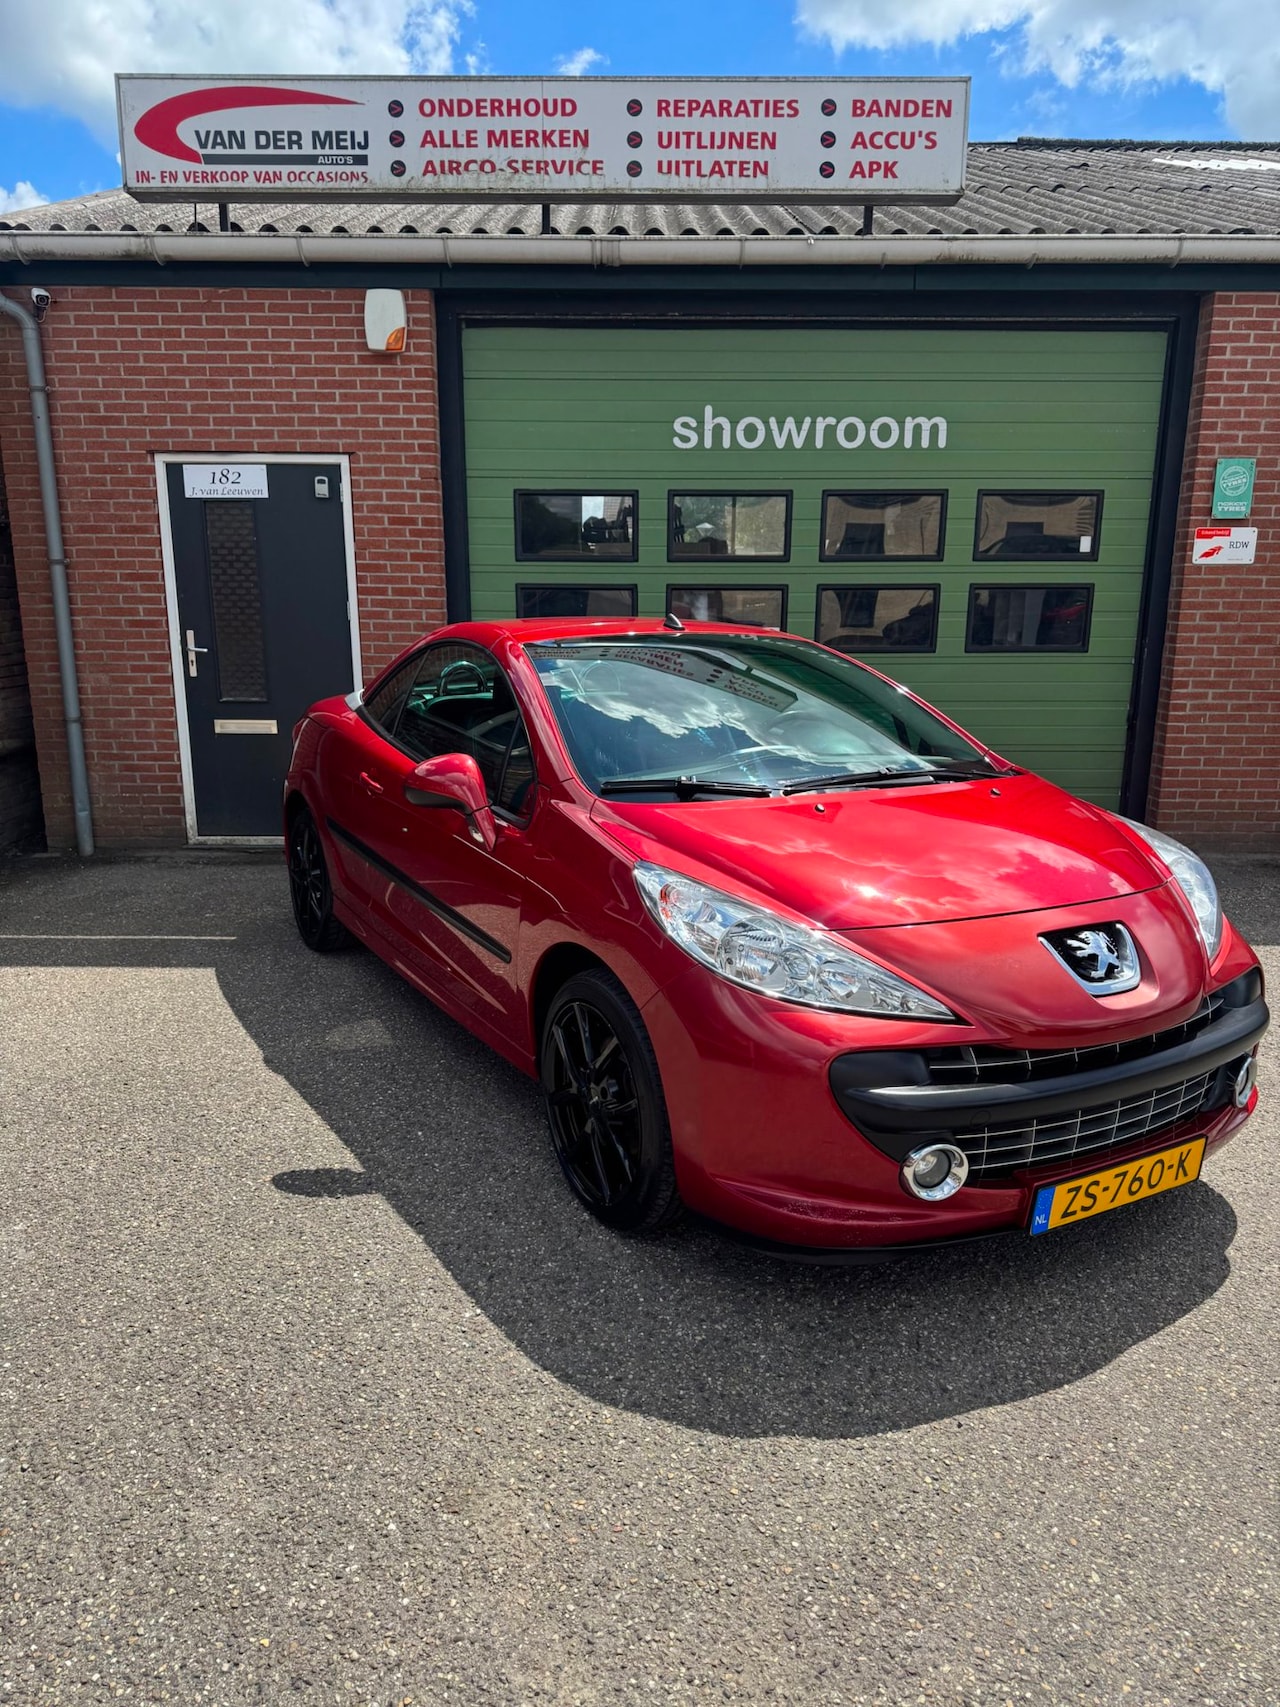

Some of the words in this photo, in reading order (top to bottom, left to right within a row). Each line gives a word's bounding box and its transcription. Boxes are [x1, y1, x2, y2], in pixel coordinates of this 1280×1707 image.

[418, 98, 577, 118] ONDERHOUD
[656, 99, 800, 118] REPARATIES
[851, 99, 952, 118] BANDEN
[195, 130, 246, 150] VAN
[254, 130, 303, 150] DER
[311, 130, 370, 150] MEIJ
[420, 129, 478, 148] ALLE
[487, 129, 590, 148] MERKEN
[657, 131, 777, 150] UITLIJNEN
[850, 131, 938, 150] ACCU'S
[317, 155, 354, 165] AUTO'S
[422, 160, 604, 176] AIRCO-SERVICE
[657, 160, 769, 178] UITLATEN
[135, 170, 156, 183] IN-
[160, 170, 179, 183] EN
[182, 170, 249, 184] VERKOOP
[253, 171, 283, 184] VAN
[287, 171, 369, 184] OCCASIONS
[849, 161, 899, 179] APK
[672, 404, 948, 449] showroom
[209, 468, 242, 485] 182
[189, 486, 198, 497] J.
[200, 488, 219, 496] van
[221, 486, 264, 496] Leeuwen
[1228, 541, 1250, 549] RDW
[1060, 1148, 1192, 1219] ZS-760-K
[1034, 1213, 1048, 1226] NL
